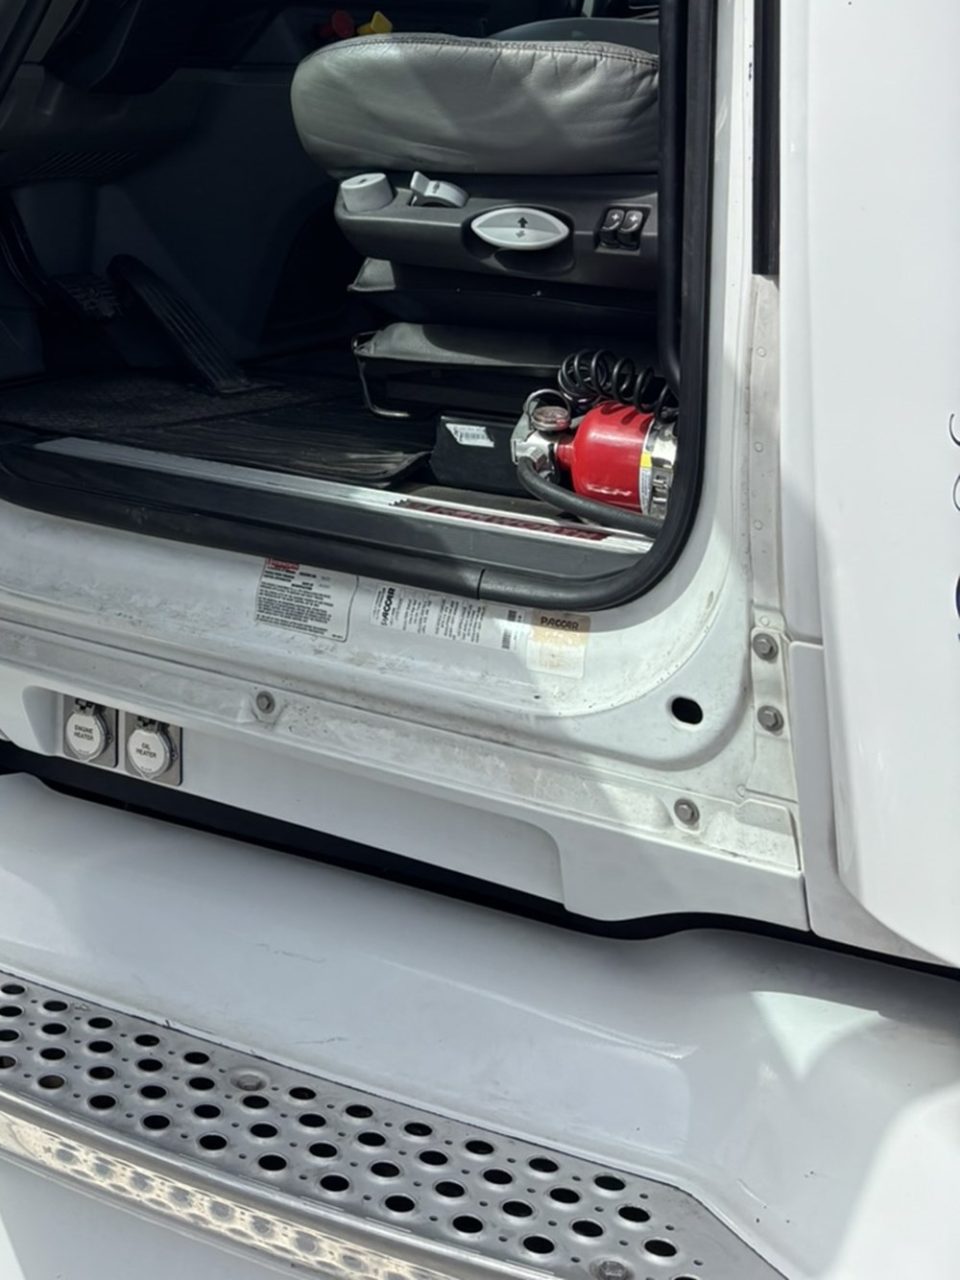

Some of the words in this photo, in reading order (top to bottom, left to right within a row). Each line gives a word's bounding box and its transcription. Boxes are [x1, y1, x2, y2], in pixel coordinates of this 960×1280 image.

[540, 616, 579, 630] PACCAR
[73, 731, 94, 741] HEATER
[136, 748, 157, 758] HEATER
